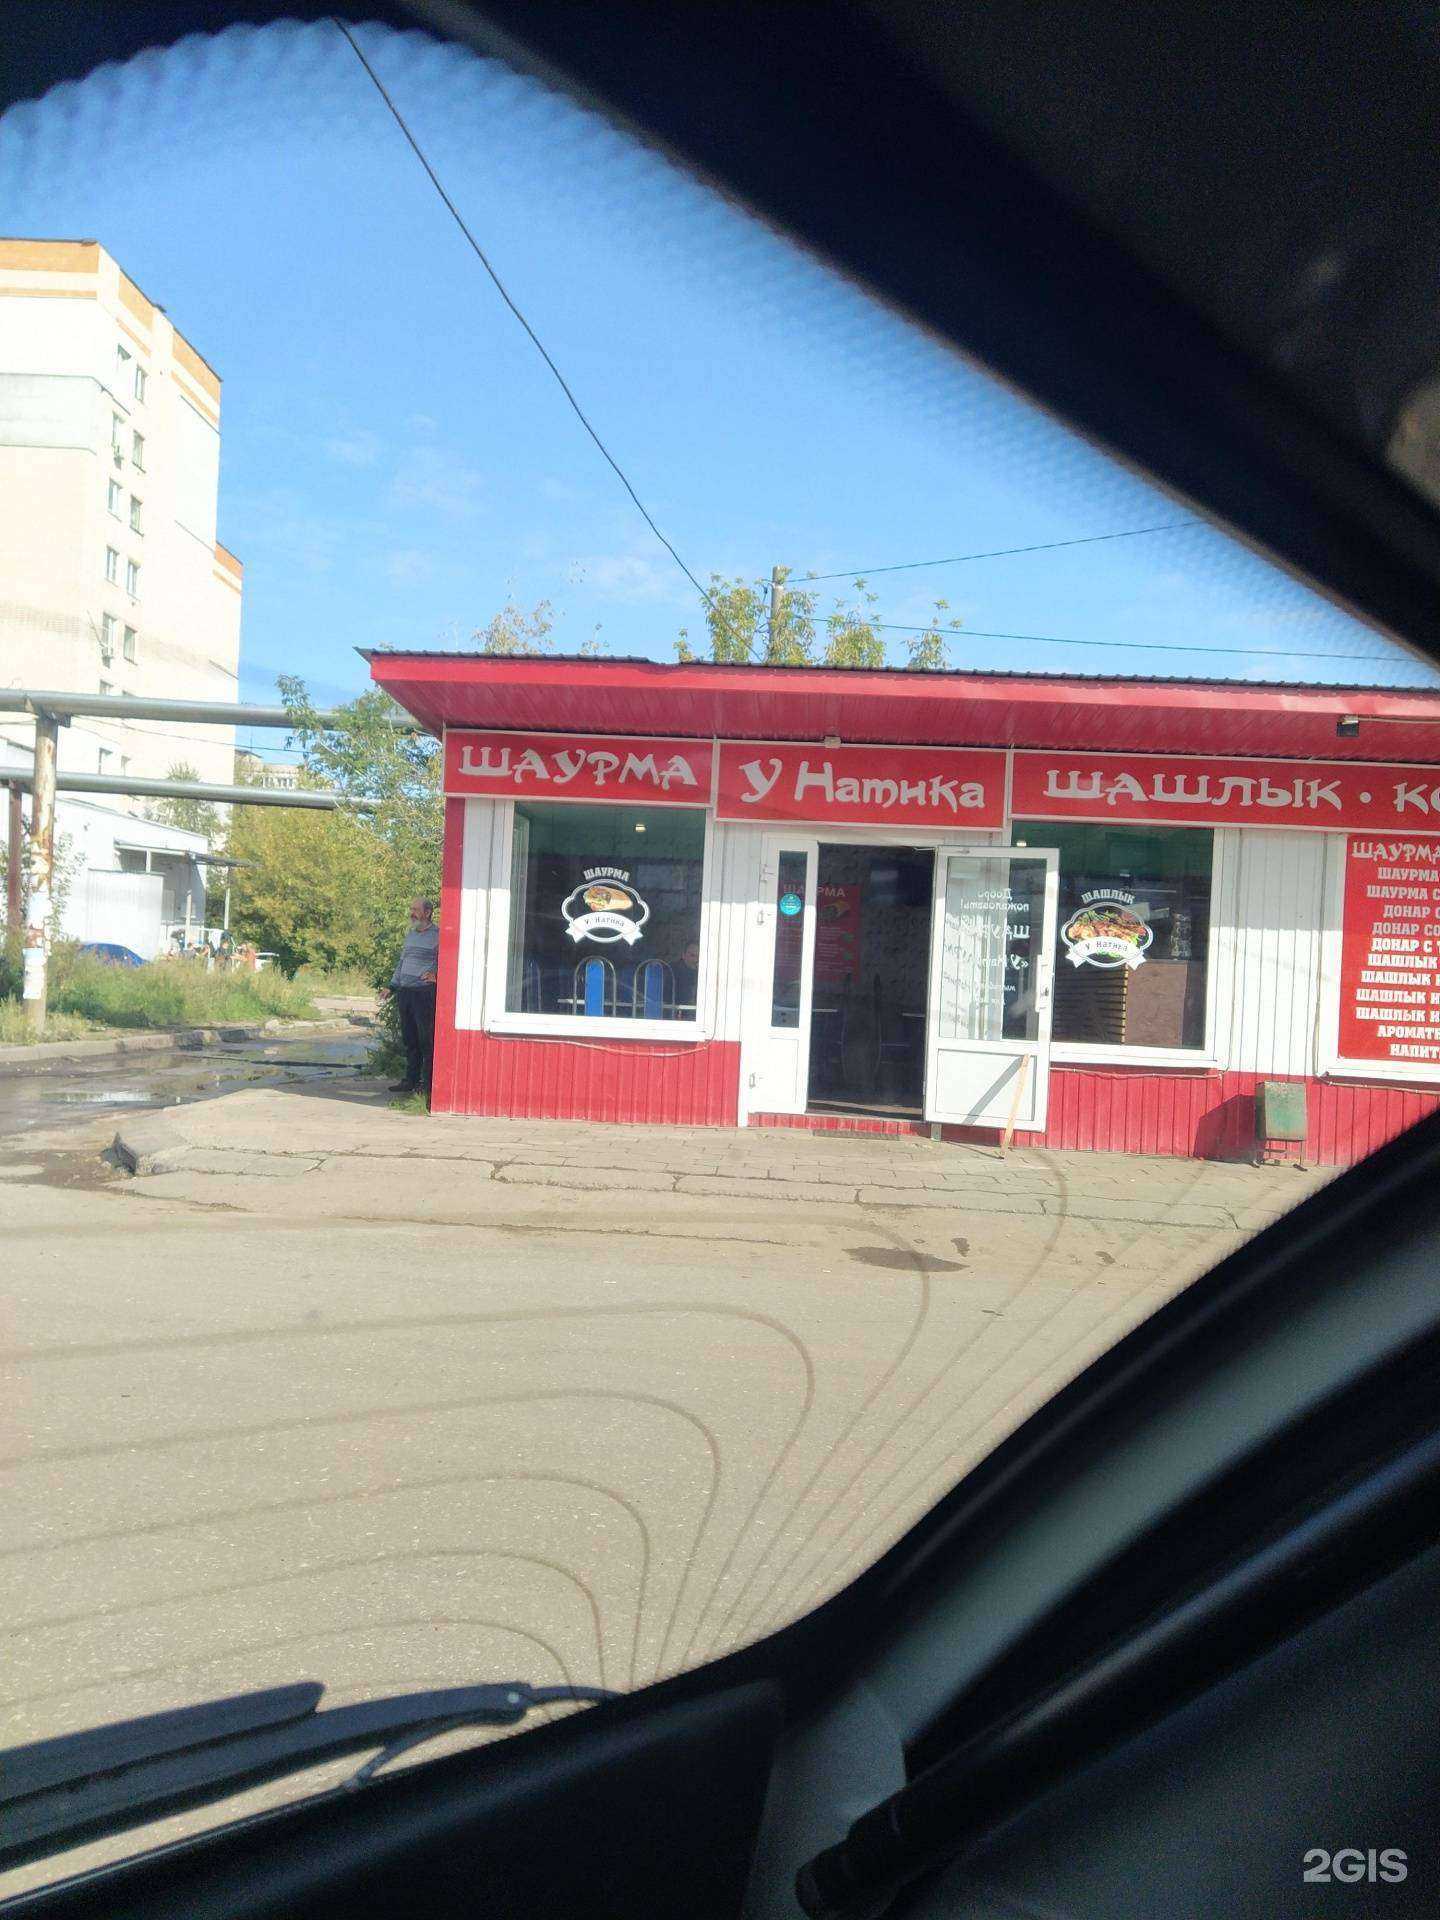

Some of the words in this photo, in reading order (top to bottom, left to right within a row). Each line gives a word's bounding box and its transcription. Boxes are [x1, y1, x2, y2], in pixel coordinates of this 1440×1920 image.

[457, 745, 698, 791] ШАУРМА
[738, 758, 783, 803] У
[1042, 769, 1342, 812] ШАШЛЫК
[583, 866, 631, 882] ШАУРМА
[1377, 867, 1440, 882] ШАУРМА
[1081, 888, 1136, 905] ШАШЛЫК
[1366, 885, 1428, 900] ШАУРМА
[1383, 904, 1431, 918] ДОНАР
[1372, 921, 1420, 936] ДОНАР
[1371, 937, 1420, 952] ДОНАР
[1367, 953, 1438, 970] ШАШЛЫК
[1360, 970, 1431, 986] ШАШЛЫК
[1355, 988, 1426, 1004] ШАШЛЫК
[1355, 1006, 1426, 1022] ШАШЛЫК
